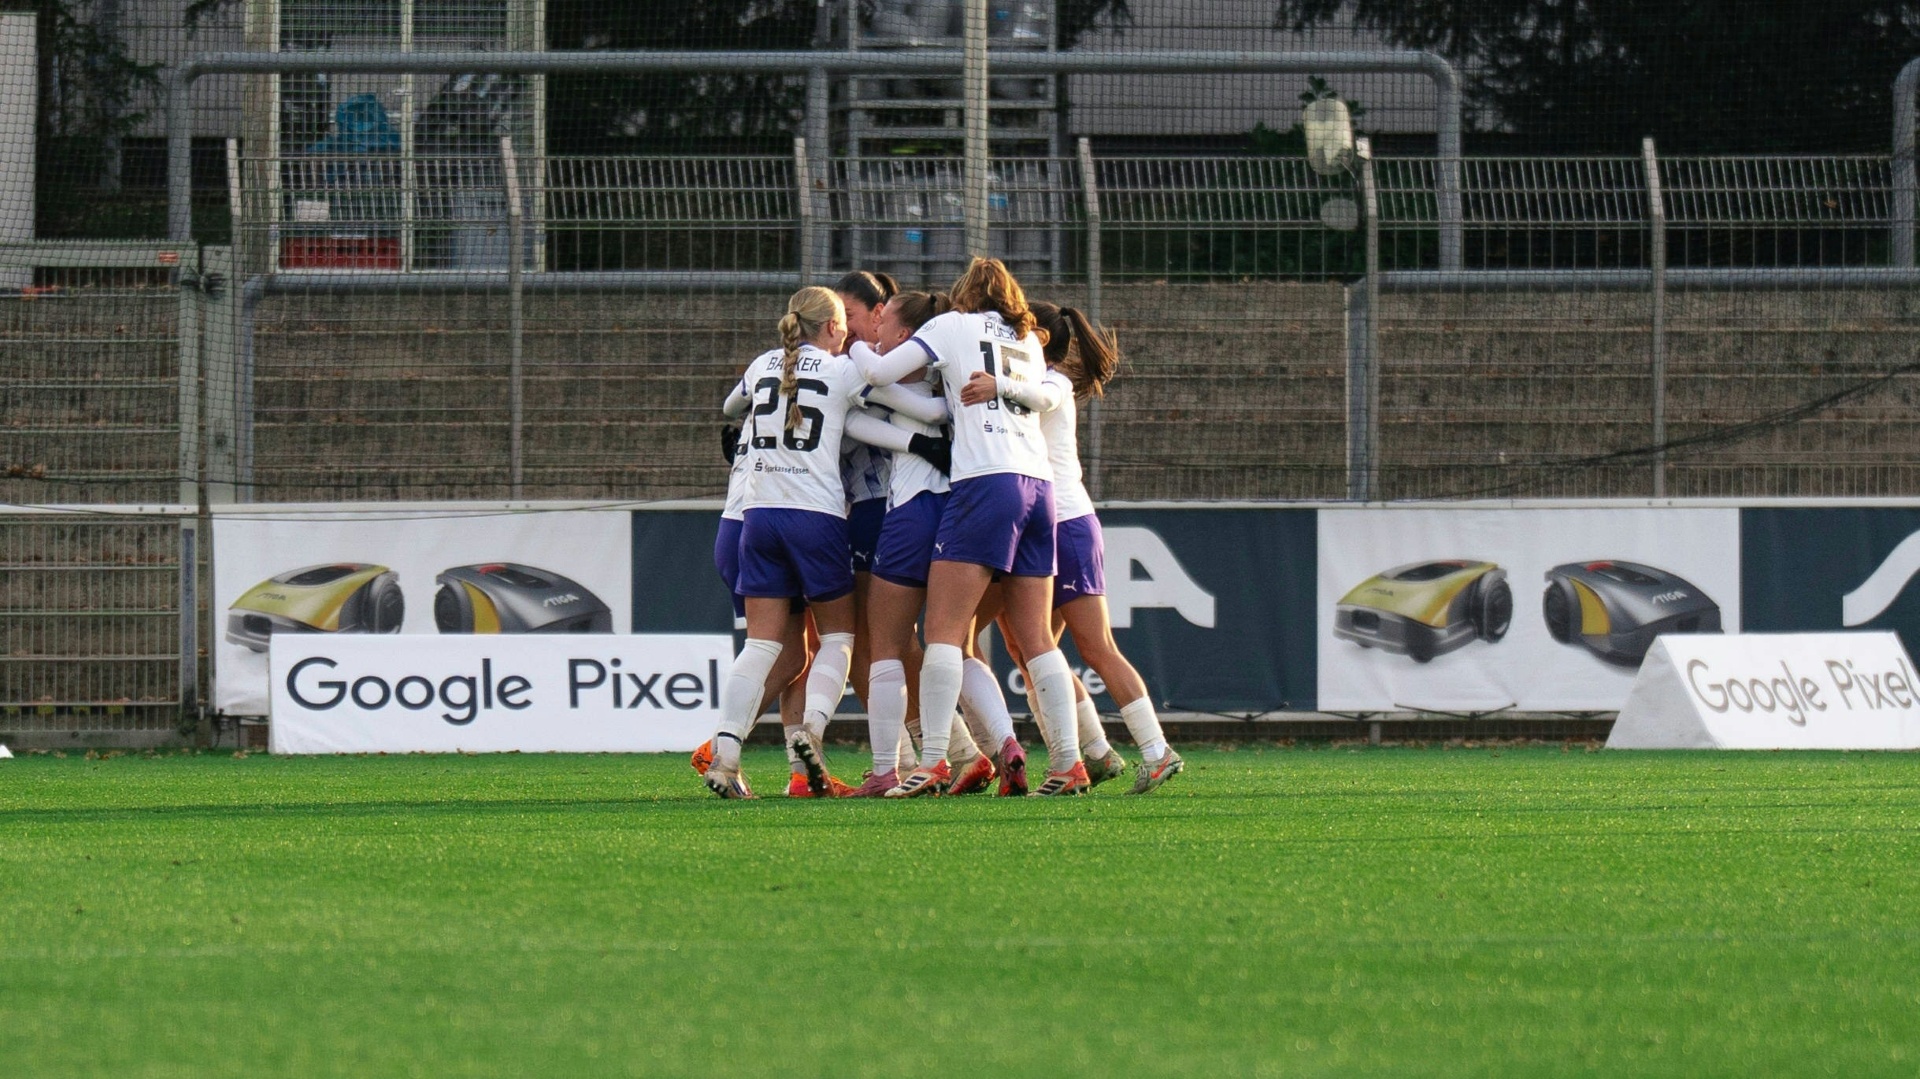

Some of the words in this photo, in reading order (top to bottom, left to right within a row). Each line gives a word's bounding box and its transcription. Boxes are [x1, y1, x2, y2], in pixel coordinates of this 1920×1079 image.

[766, 357, 822, 373] BAKER
[979, 340, 1031, 415] 15
[751, 376, 829, 453] 26
[542, 593, 580, 608] STIGA
[1652, 590, 1688, 605] STIGA
[286, 656, 533, 726] Google
[567, 657, 720, 710] Pixel
[1686, 658, 1828, 728] Google
[1824, 657, 1920, 710] Pixel
